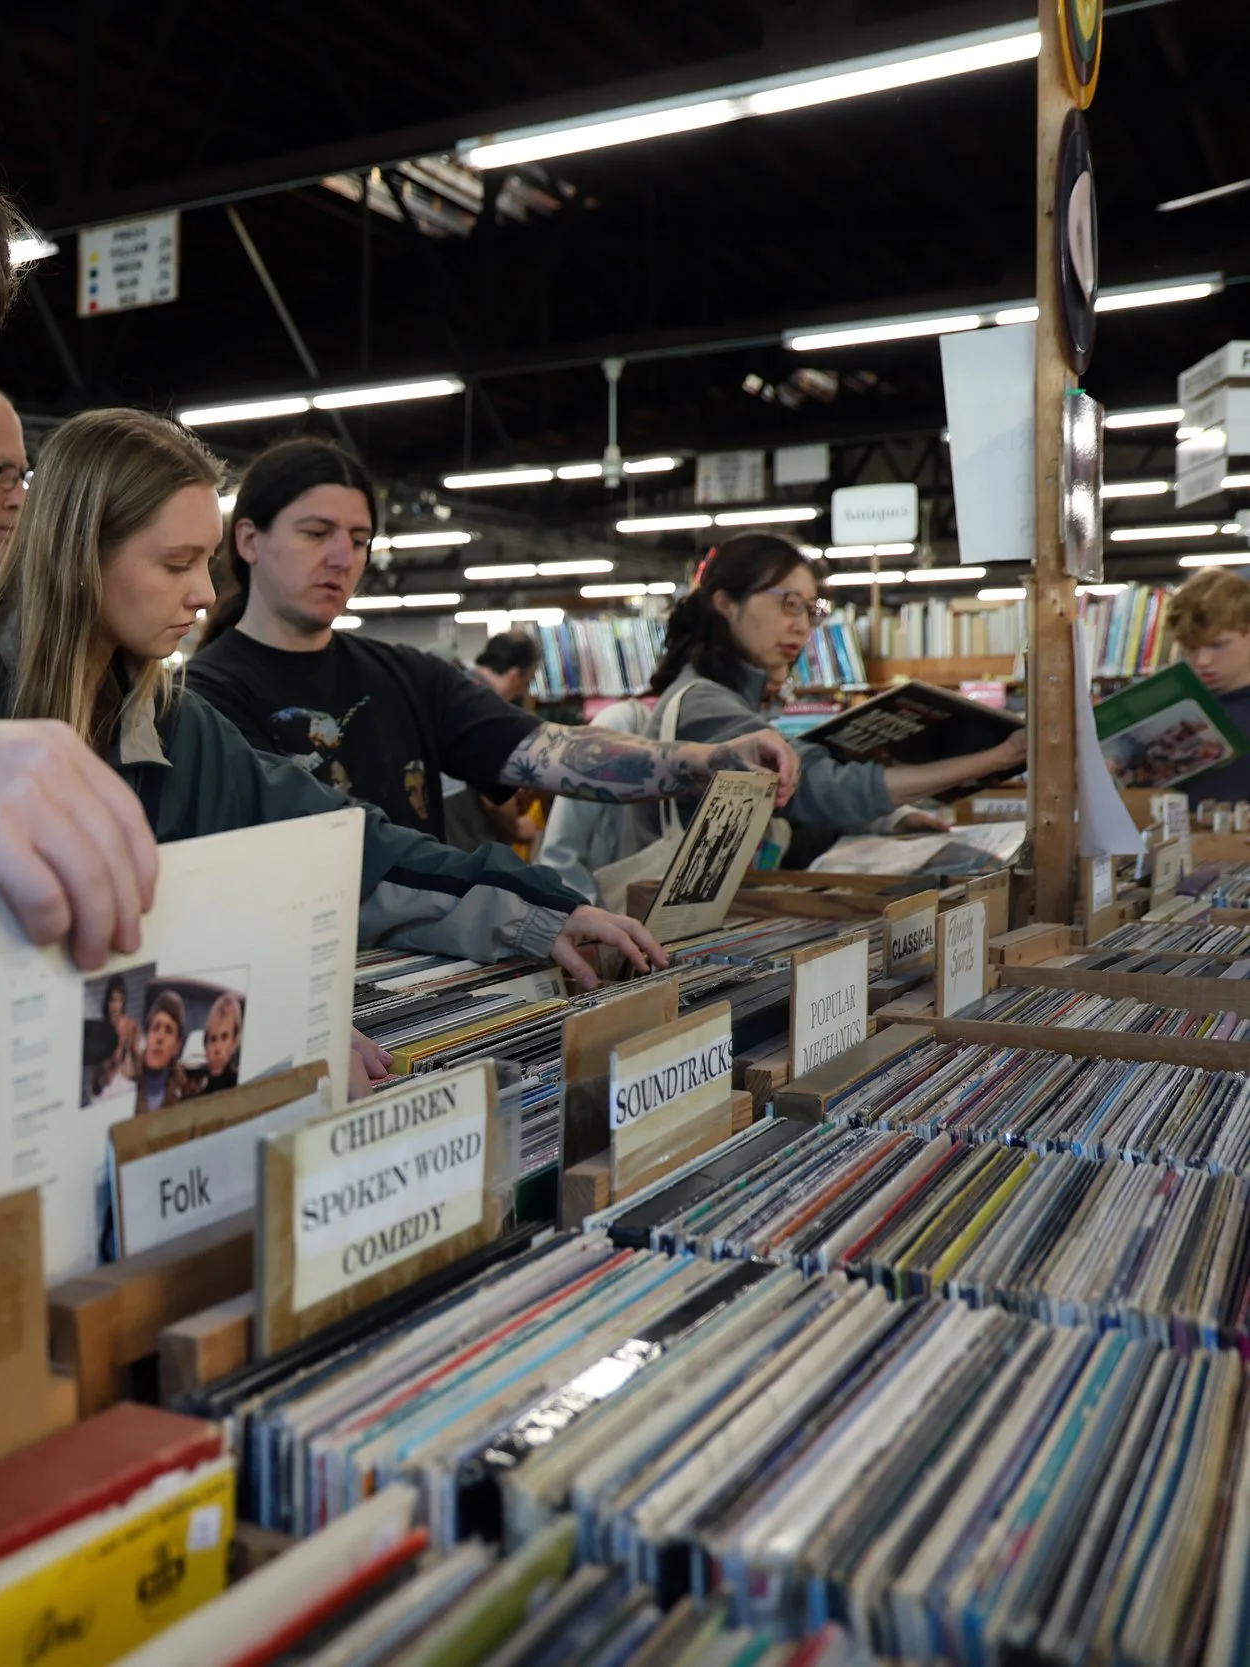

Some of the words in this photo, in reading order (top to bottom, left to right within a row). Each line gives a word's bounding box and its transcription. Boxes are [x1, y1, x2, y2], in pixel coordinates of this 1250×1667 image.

[892, 925, 934, 961] CLASSICAL
[951, 946, 975, 993] Sports
[810, 984, 856, 1030] POPULAR
[802, 1018, 861, 1075] MECHANICS
[616, 1039, 733, 1124] SOUNDTRACKS
[329, 1083, 457, 1157] CHILDREN
[160, 1166, 212, 1220] Folk
[302, 1161, 409, 1232] SPOKEN
[415, 1131, 482, 1181] WORD
[342, 1202, 445, 1275] COMEDY
